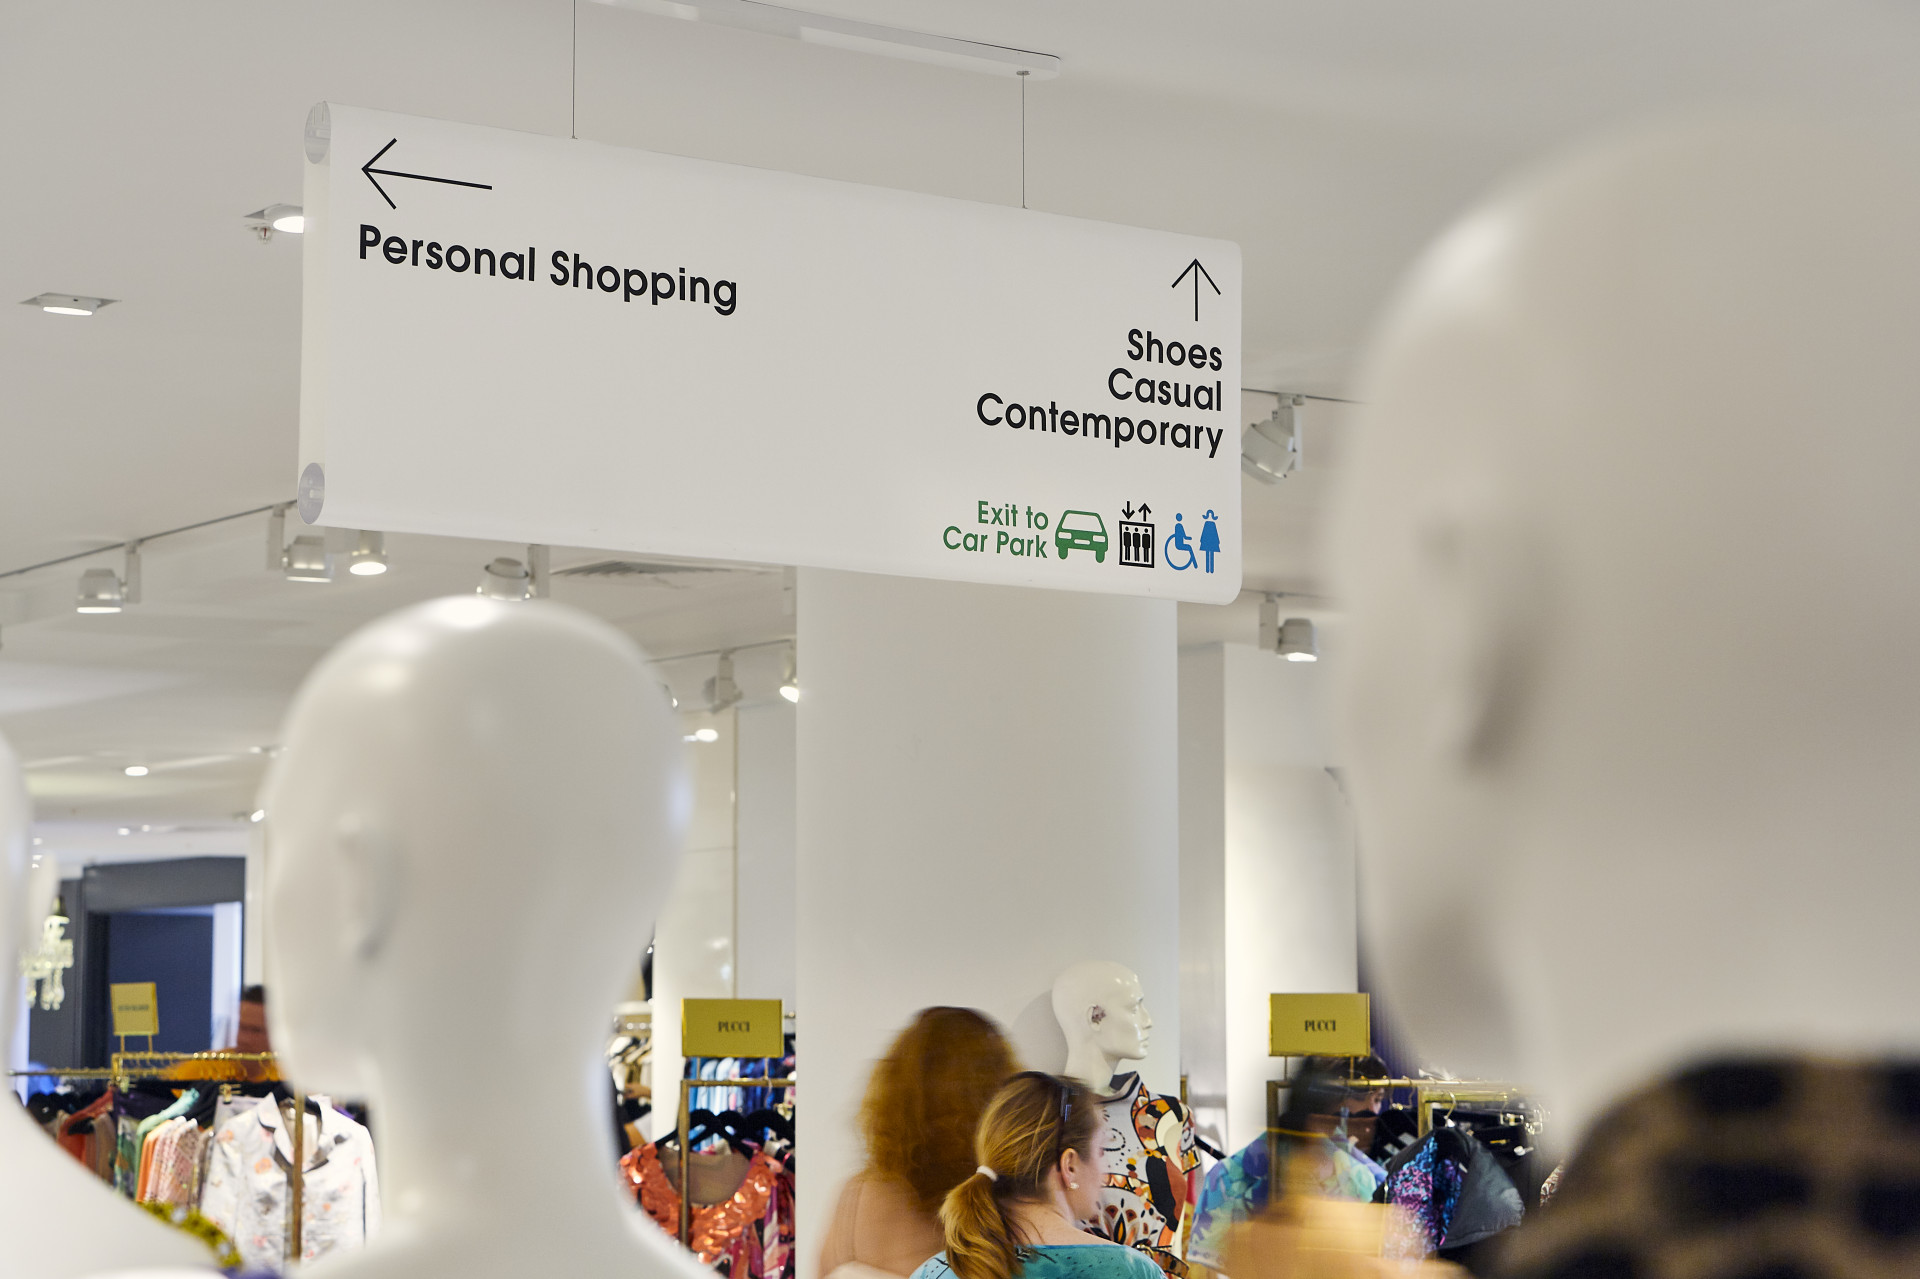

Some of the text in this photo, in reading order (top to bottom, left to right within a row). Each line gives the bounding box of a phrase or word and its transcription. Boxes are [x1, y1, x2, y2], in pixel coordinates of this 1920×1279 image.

[359, 223, 738, 317] Personal Shopping
[1126, 328, 1223, 372] Shoes
[1107, 367, 1222, 412] Casual
[976, 392, 1224, 459] Contemporary
[977, 500, 1049, 531] Exit to
[942, 525, 1048, 559] Car Park
[718, 1021, 750, 1032] PUCCI
[1304, 1019, 1337, 1032] PUCCI
